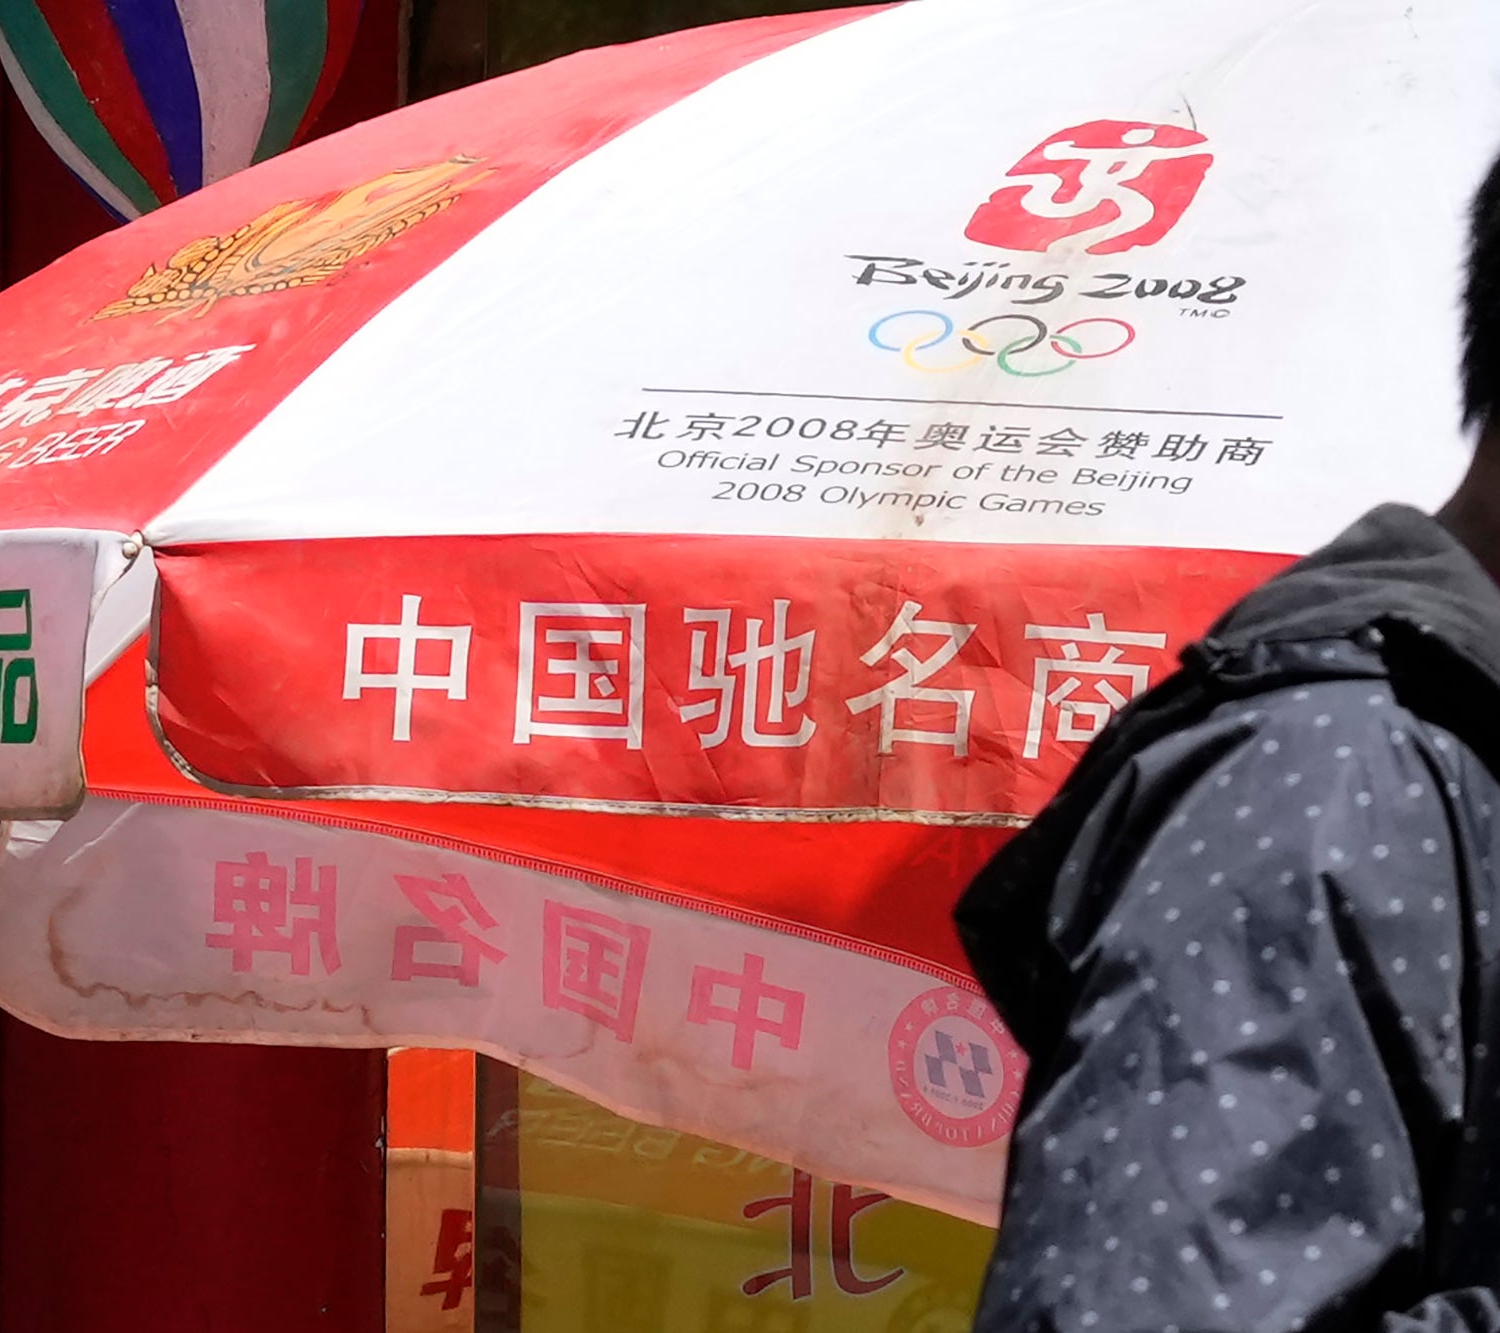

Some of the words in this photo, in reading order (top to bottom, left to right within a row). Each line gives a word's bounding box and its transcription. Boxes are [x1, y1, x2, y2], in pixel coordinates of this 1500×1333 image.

[845, 254, 1070, 305] Beijing
[1078, 273, 1247, 304] 2008
[8, 419, 146, 470] BEER
[614, 409, 1274, 468] 北京2008年奥运会赞助商
[657, 449, 780, 473] Official
[790, 453, 943, 481] Sponsor
[953, 461, 992, 481] of
[1002, 464, 1059, 485] the
[1073, 467, 1194, 495] Beijing
[712, 481, 819, 504] 2008
[820, 485, 965, 513] Olympic
[979, 493, 1105, 518] Games
